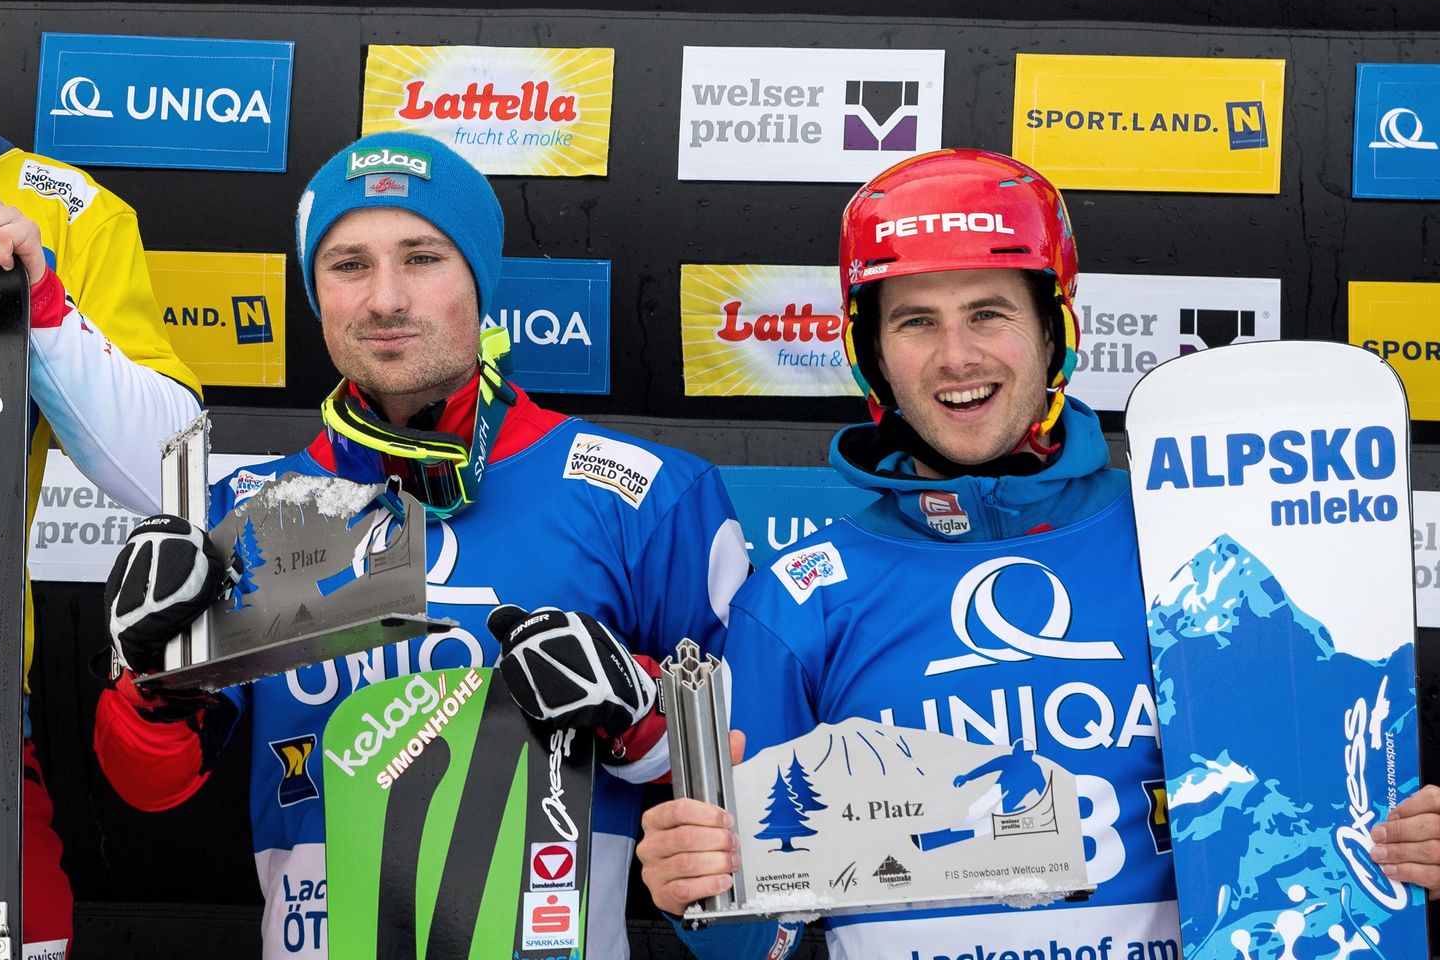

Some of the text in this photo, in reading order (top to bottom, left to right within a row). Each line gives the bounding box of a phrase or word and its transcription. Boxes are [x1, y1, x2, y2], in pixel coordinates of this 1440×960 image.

[126, 86, 271, 125] UNIQA
[397, 80, 578, 122] Lattella
[691, 78, 825, 108] welser
[689, 114, 823, 148] profile
[1025, 107, 1219, 134] SPORT.LAND.
[454, 127, 573, 147] frucht & molke
[351, 149, 428, 174] kelag
[875, 212, 1015, 244] PETROL
[777, 345, 844, 371] frucht &
[474, 415, 490, 483] SMITH
[1146, 425, 1396, 493] ALPSKO
[570, 461, 646, 497] WORLD CUP
[571, 452, 650, 489] SNOWBOARD
[1271, 488, 1399, 527] mleko
[930, 520, 968, 536] triglav
[274, 546, 327, 576] 3. Platz
[325, 674, 440, 777] kelag
[883, 681, 1161, 752] NIQA
[1386, 732, 1396, 784] snowsport
[842, 798, 924, 822] 4. Platz
[756, 873, 796, 882] Lackenhof
[756, 879, 810, 892] ÖTSCHER
[944, 862, 1070, 880] FIS Snowboard Weltcup 2018
[524, 938, 575, 947] SPARKASSE
